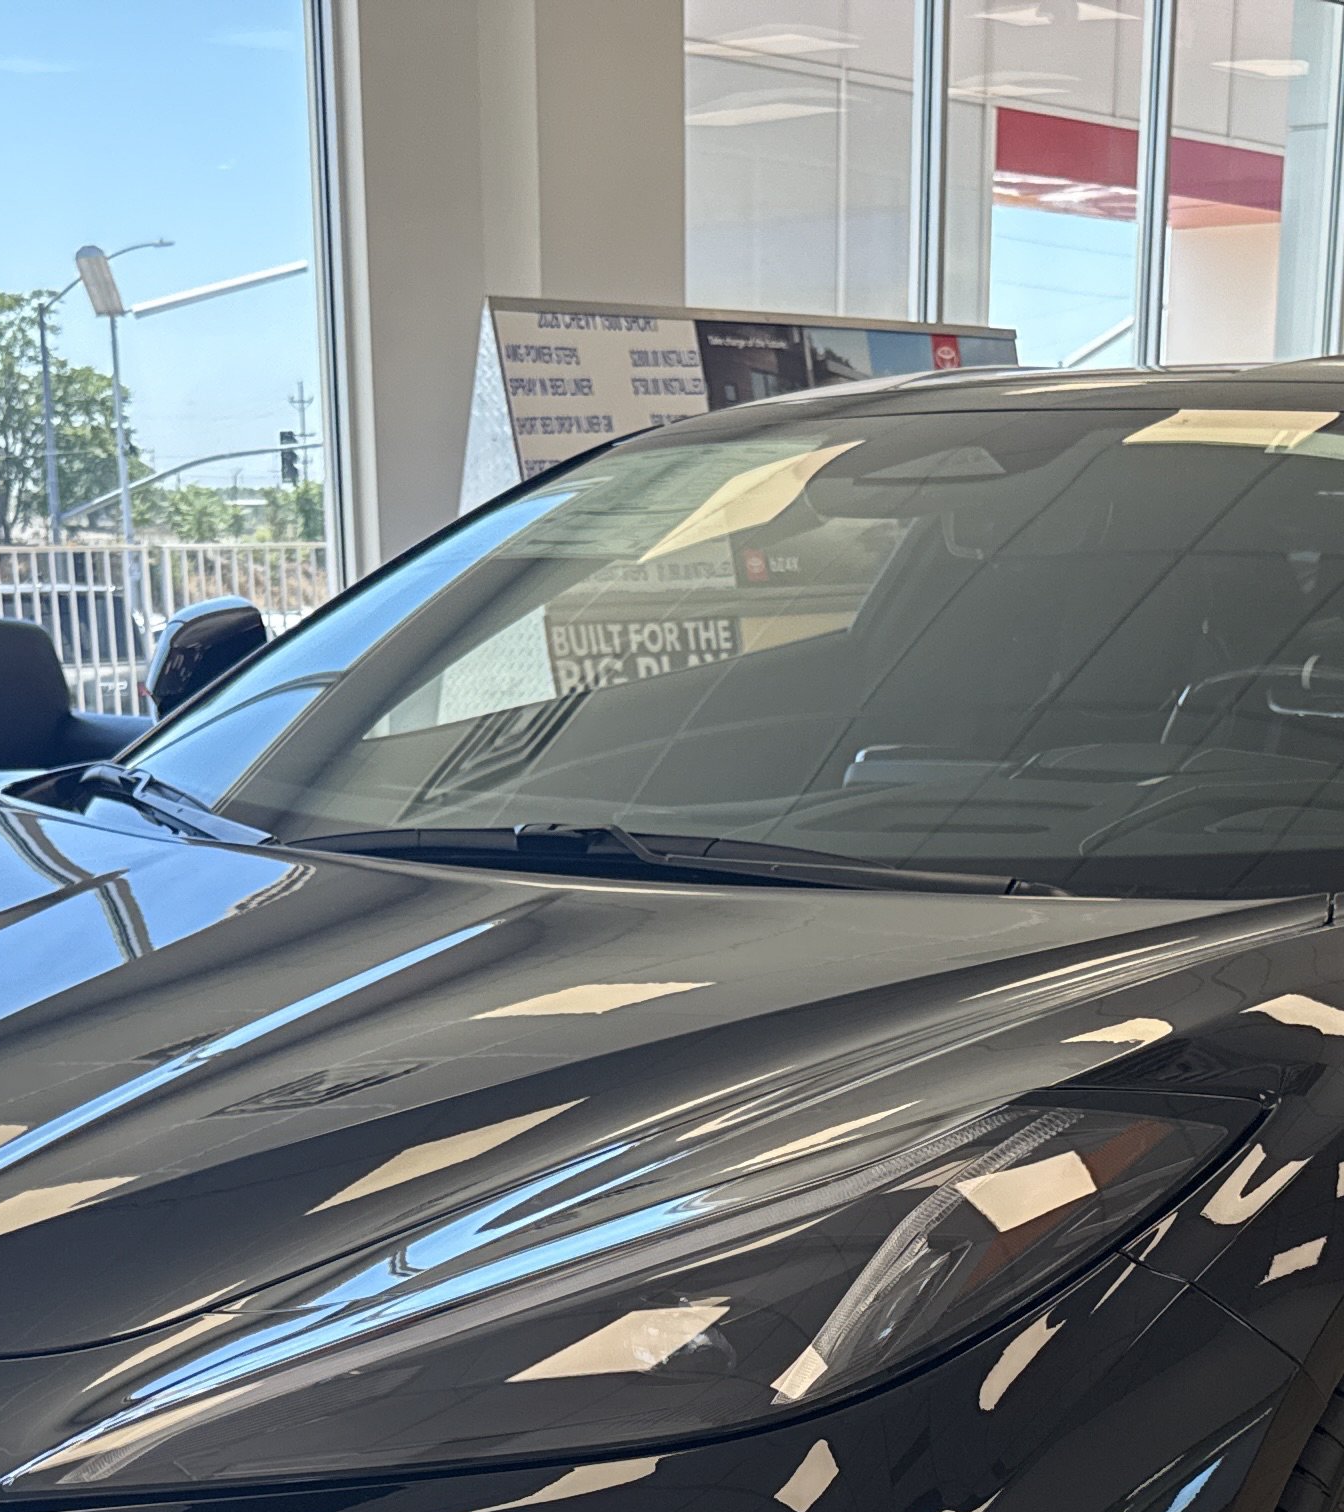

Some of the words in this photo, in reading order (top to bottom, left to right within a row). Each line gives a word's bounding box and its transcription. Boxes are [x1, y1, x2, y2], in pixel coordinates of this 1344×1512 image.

[552, 622, 623, 656] BUILT
[628, 621, 681, 653] FOR
[682, 618, 734, 650] THE
